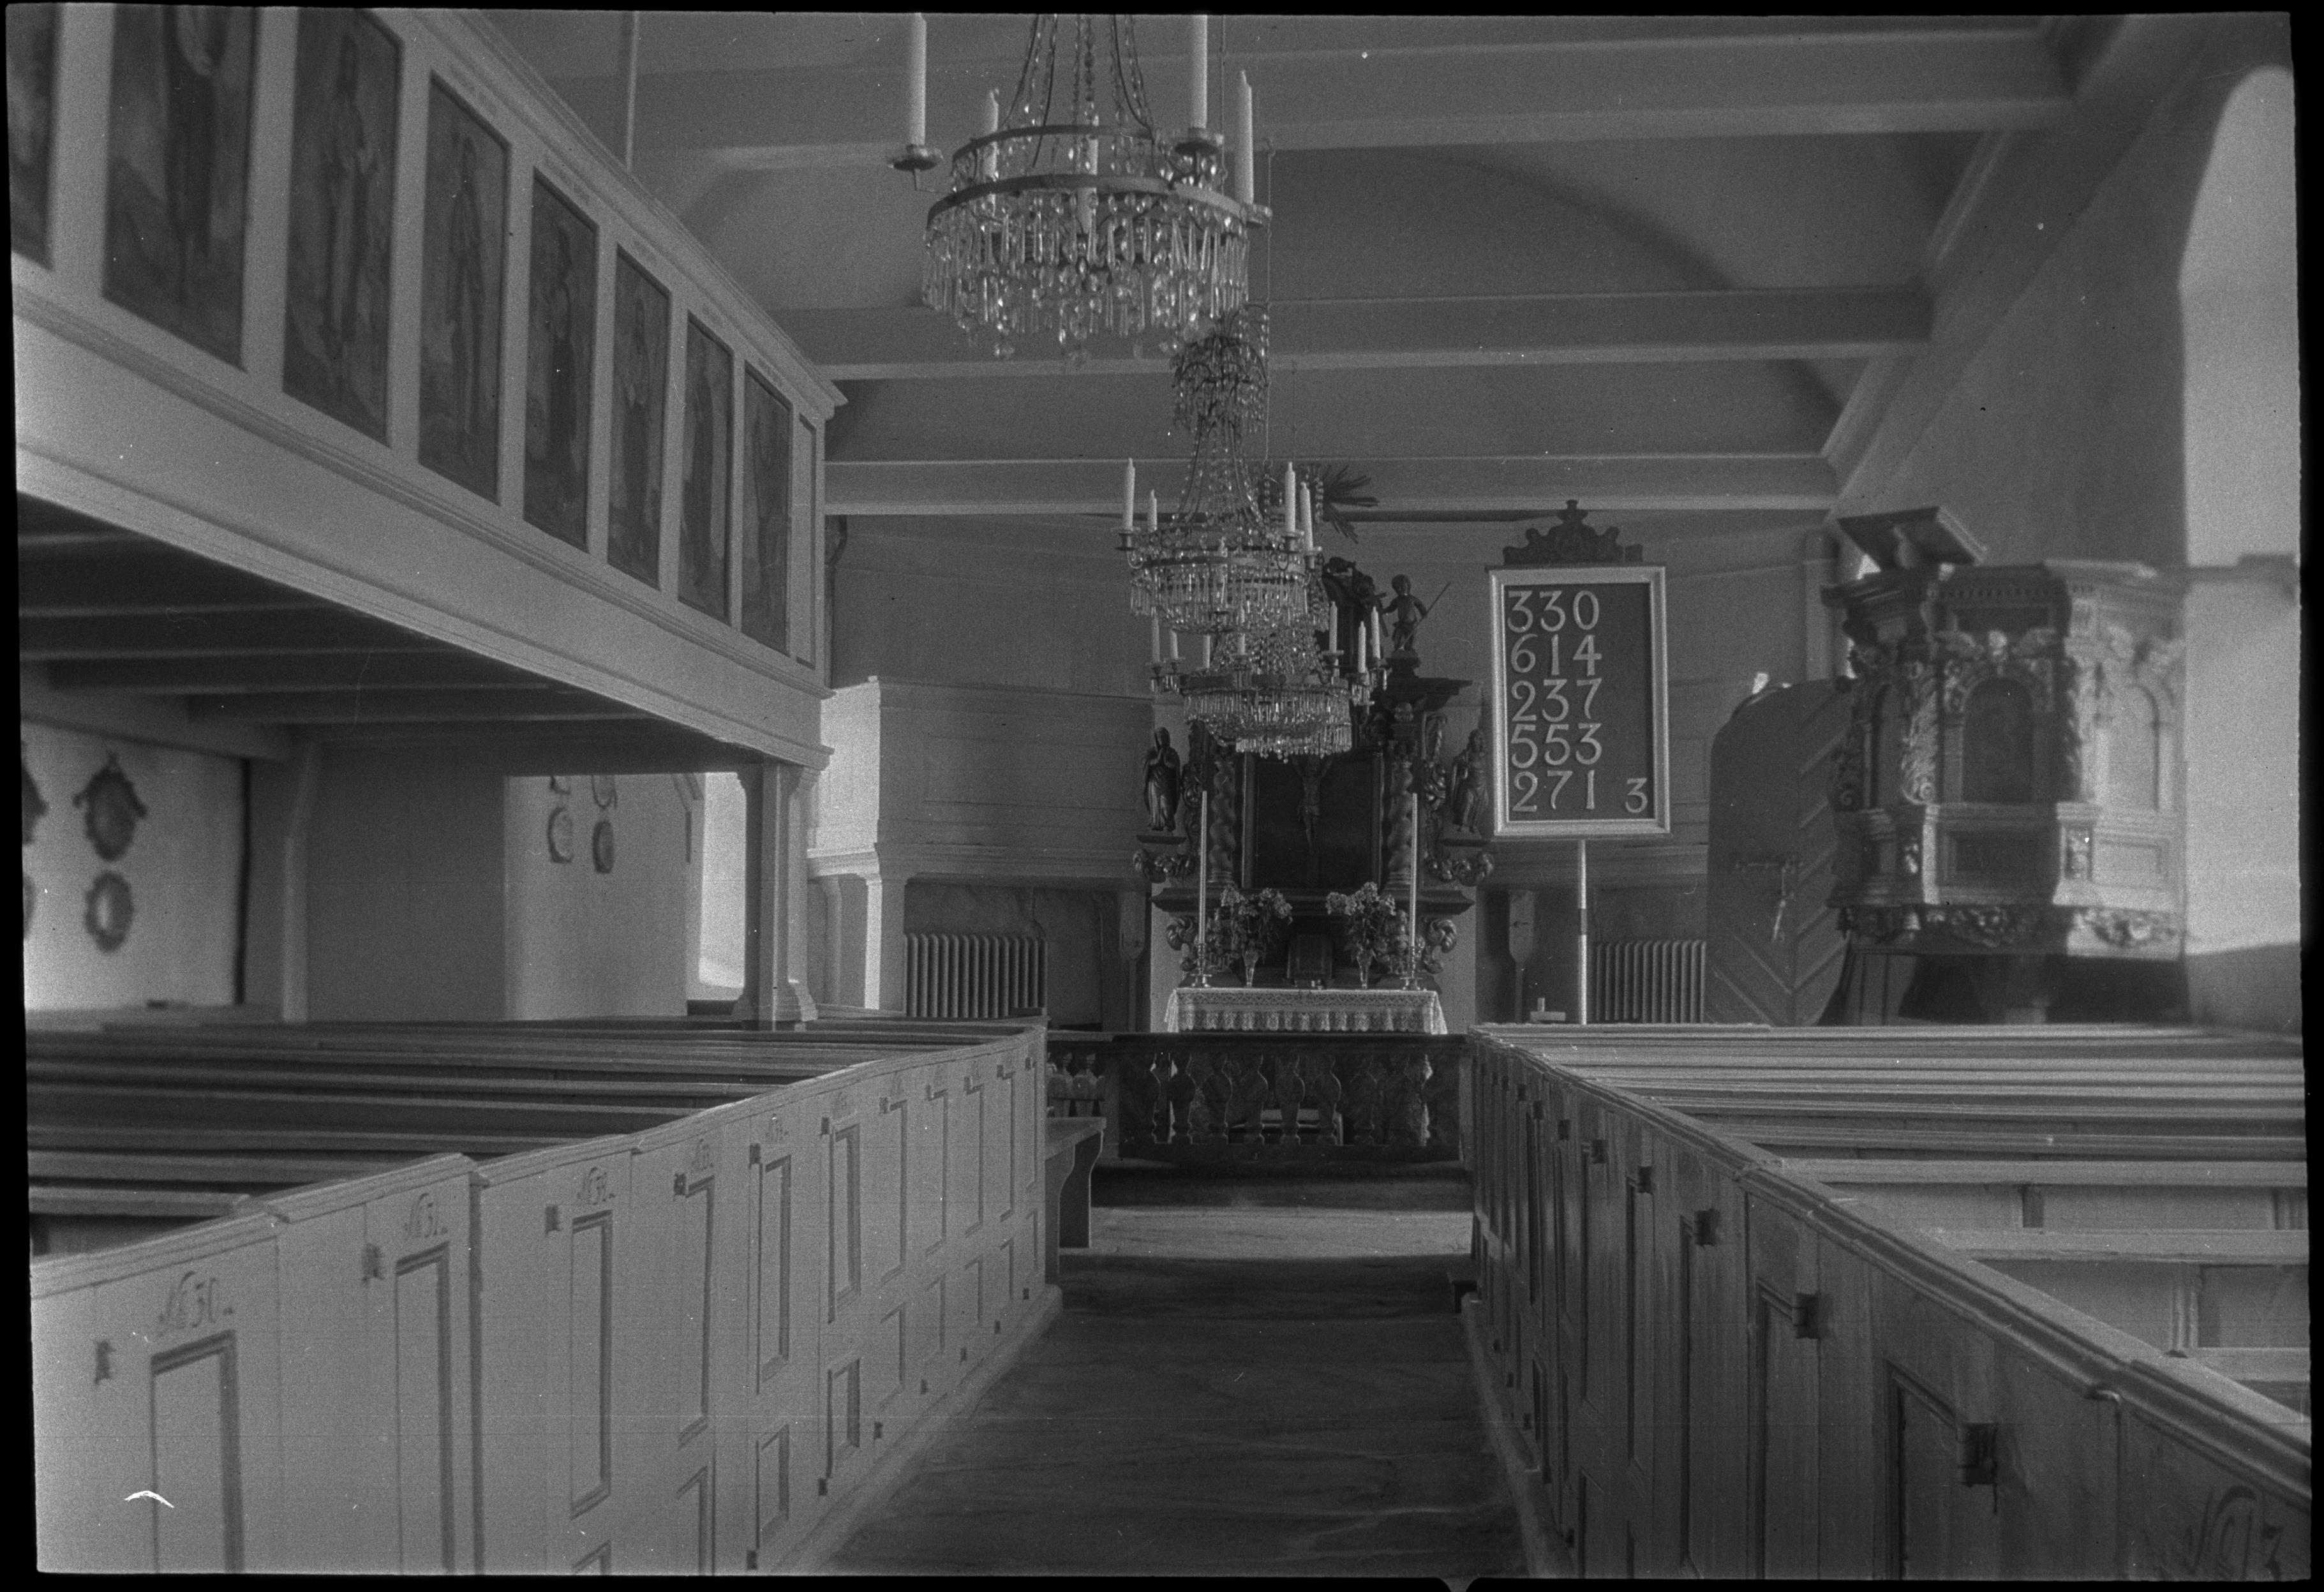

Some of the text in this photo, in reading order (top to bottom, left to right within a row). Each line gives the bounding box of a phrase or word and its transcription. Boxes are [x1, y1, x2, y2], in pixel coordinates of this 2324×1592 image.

[1507, 590, 1599, 632] 330
[1511, 634, 1602, 676] 614
[1511, 678, 1602, 722] 237
[1510, 723, 1602, 768] 553
[1512, 770, 1648, 814] 271 3
